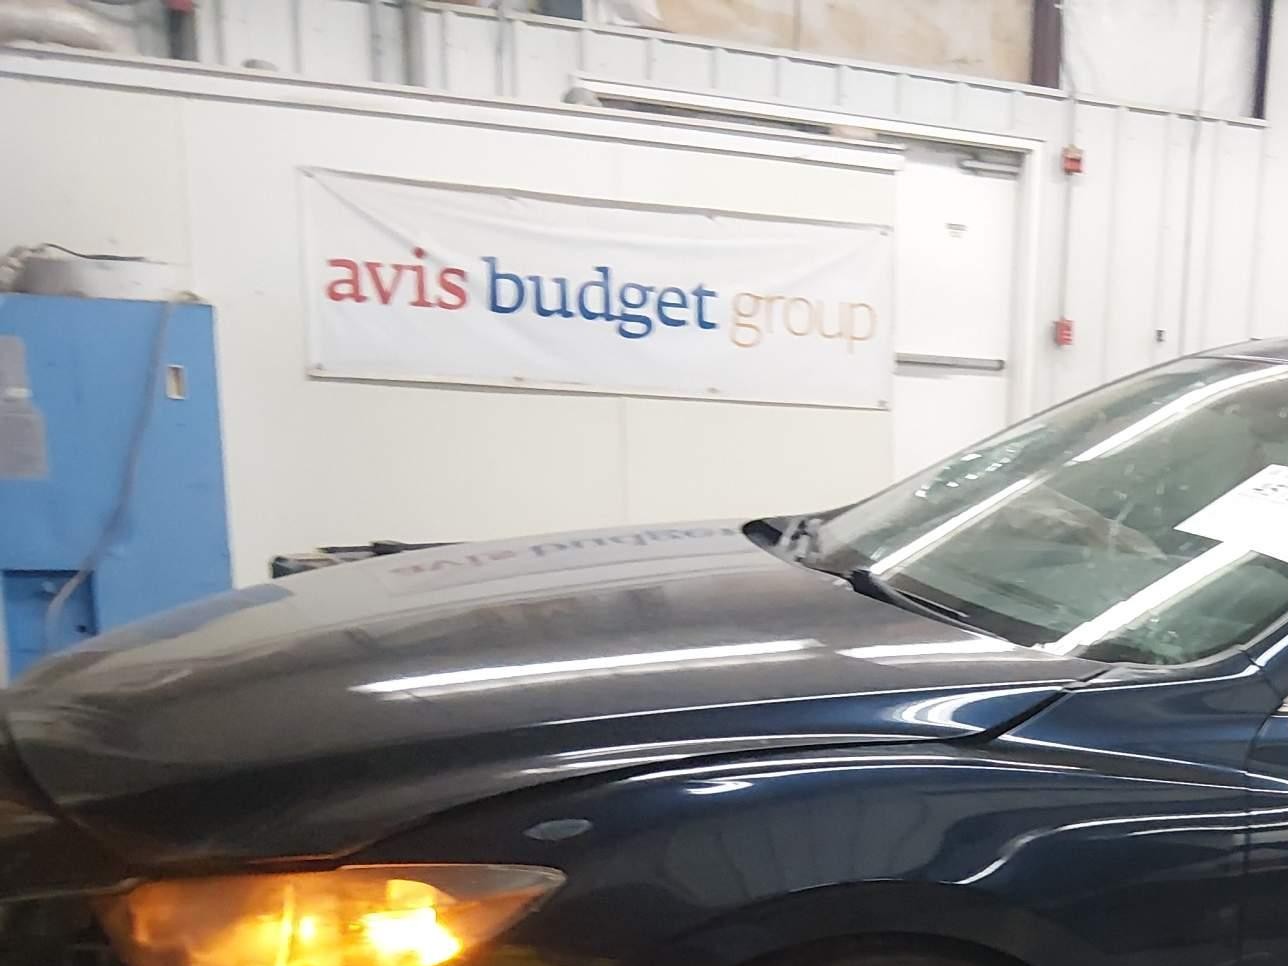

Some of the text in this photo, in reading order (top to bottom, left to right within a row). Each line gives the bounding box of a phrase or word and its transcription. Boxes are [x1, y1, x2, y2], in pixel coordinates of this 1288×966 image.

[324, 246, 878, 353] avis budget group
